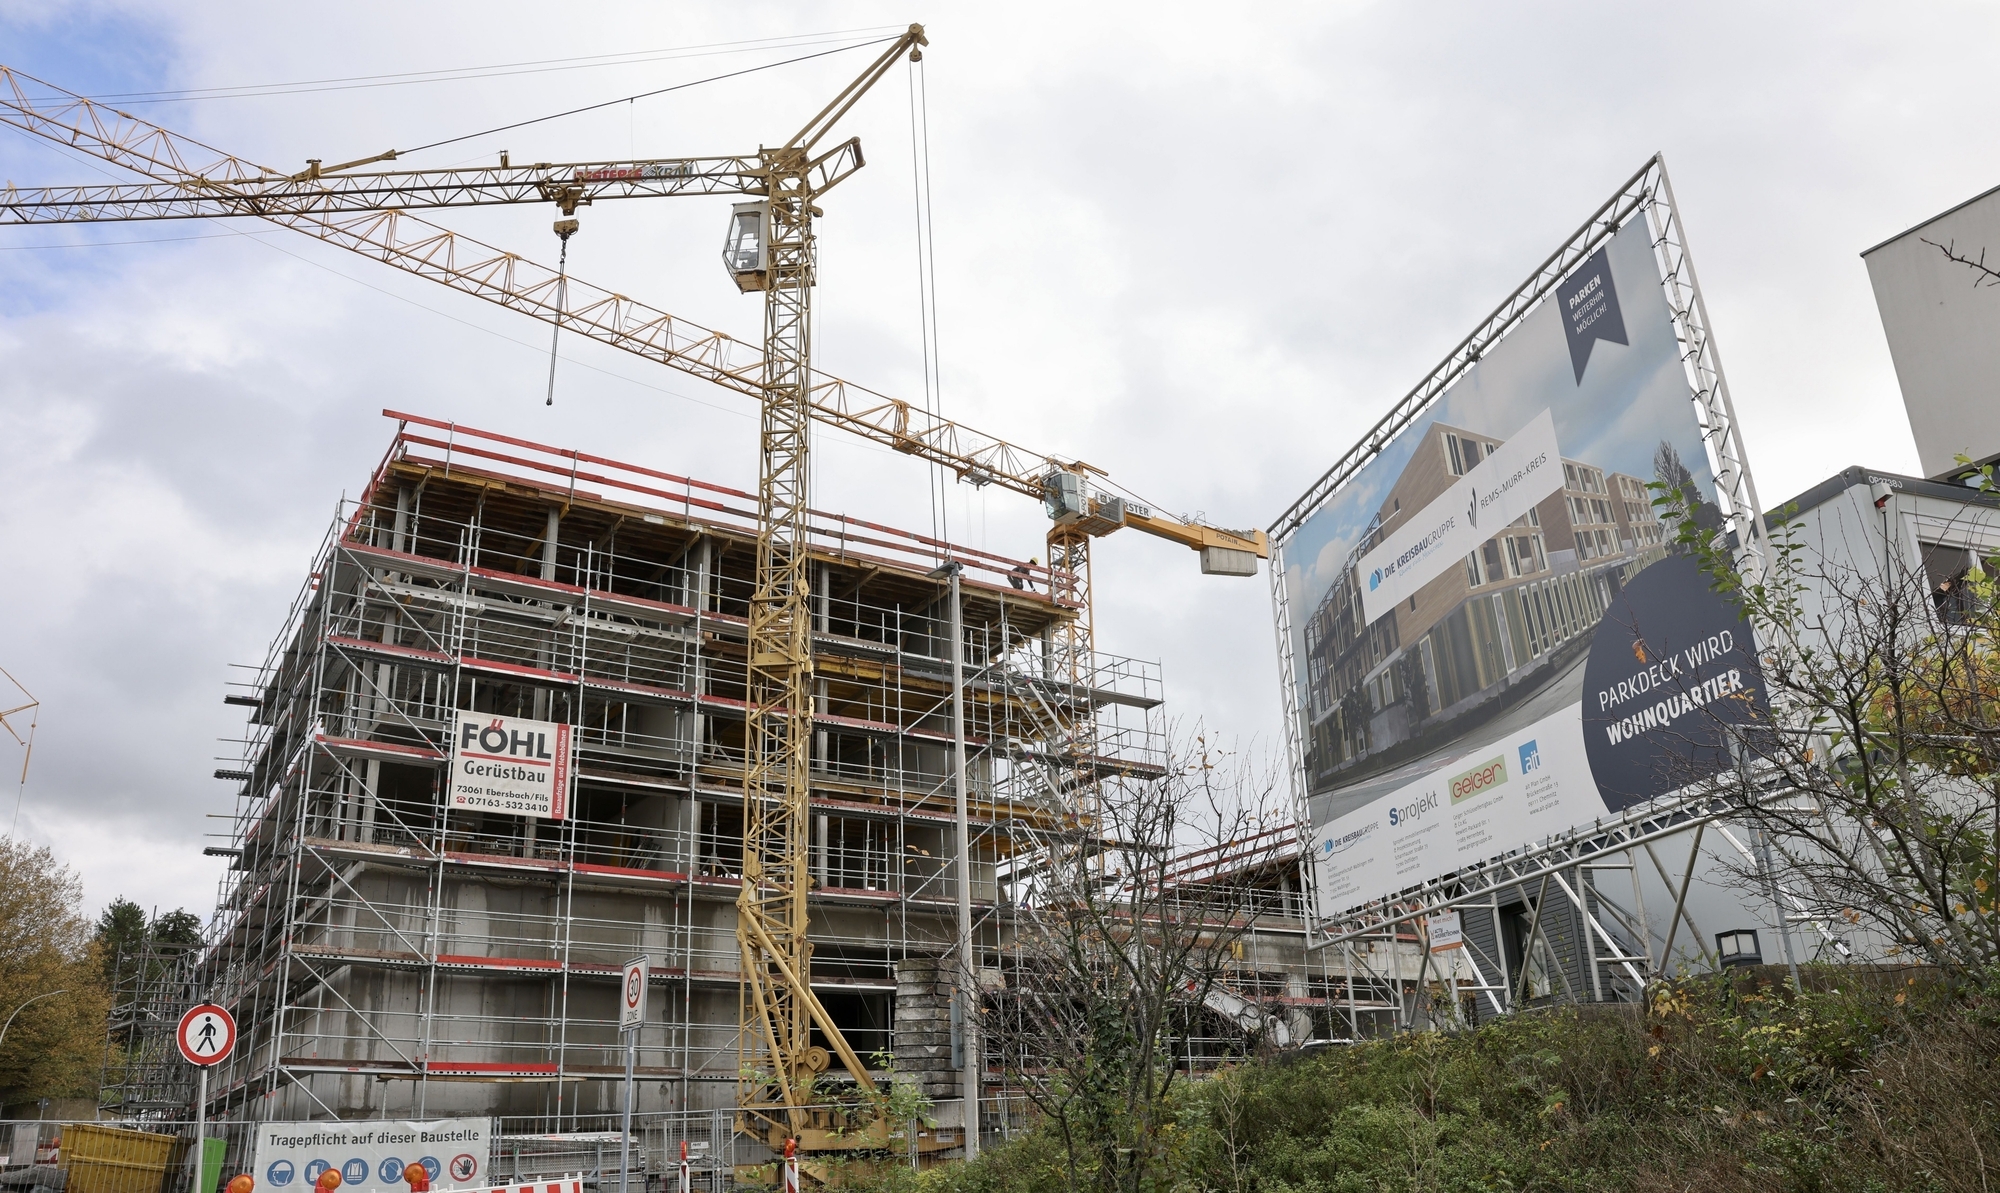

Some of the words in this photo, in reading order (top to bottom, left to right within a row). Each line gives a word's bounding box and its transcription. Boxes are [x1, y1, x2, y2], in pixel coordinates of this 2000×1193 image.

[1569, 274, 1601, 309] PARKEN
[1572, 290, 1604, 322] WEITERHIN
[1576, 302, 1608, 335] MÖGLICH!
[1480, 452, 1547, 509] REMS-MURR-KREIS
[1216, 533, 1238, 545] POTAIN
[1384, 562, 1396, 578] DIE
[1396, 516, 1456, 569] KREISBAUGRUPPE
[1599, 654, 1683, 712] PARKDECK
[1685, 630, 1734, 669] WIRD
[1606, 668, 1744, 746] WOHNQUARTIER
[461, 718, 552, 760] FÖHL
[558, 730, 567, 766] Hebebühnen
[464, 760, 545, 782] Gerüstbau
[457, 785, 482, 794] 73061
[486, 788, 548, 802] Ebersbach/Fils
[555, 780, 564, 814] Bauaufzüge
[1389, 790, 1438, 828] Sprojekt
[1539, 791, 1557, 802] Chemnitz
[1342, 821, 1379, 844] KREISBAUGRUPPE
[630, 978, 638, 997] 30
[626, 1010, 638, 1022] ZONE
[270, 1134, 347, 1149] Tragepflicht
[351, 1133, 373, 1144] auf
[377, 1132, 416, 1144] dieser
[420, 1130, 479, 1143] Baustelle
